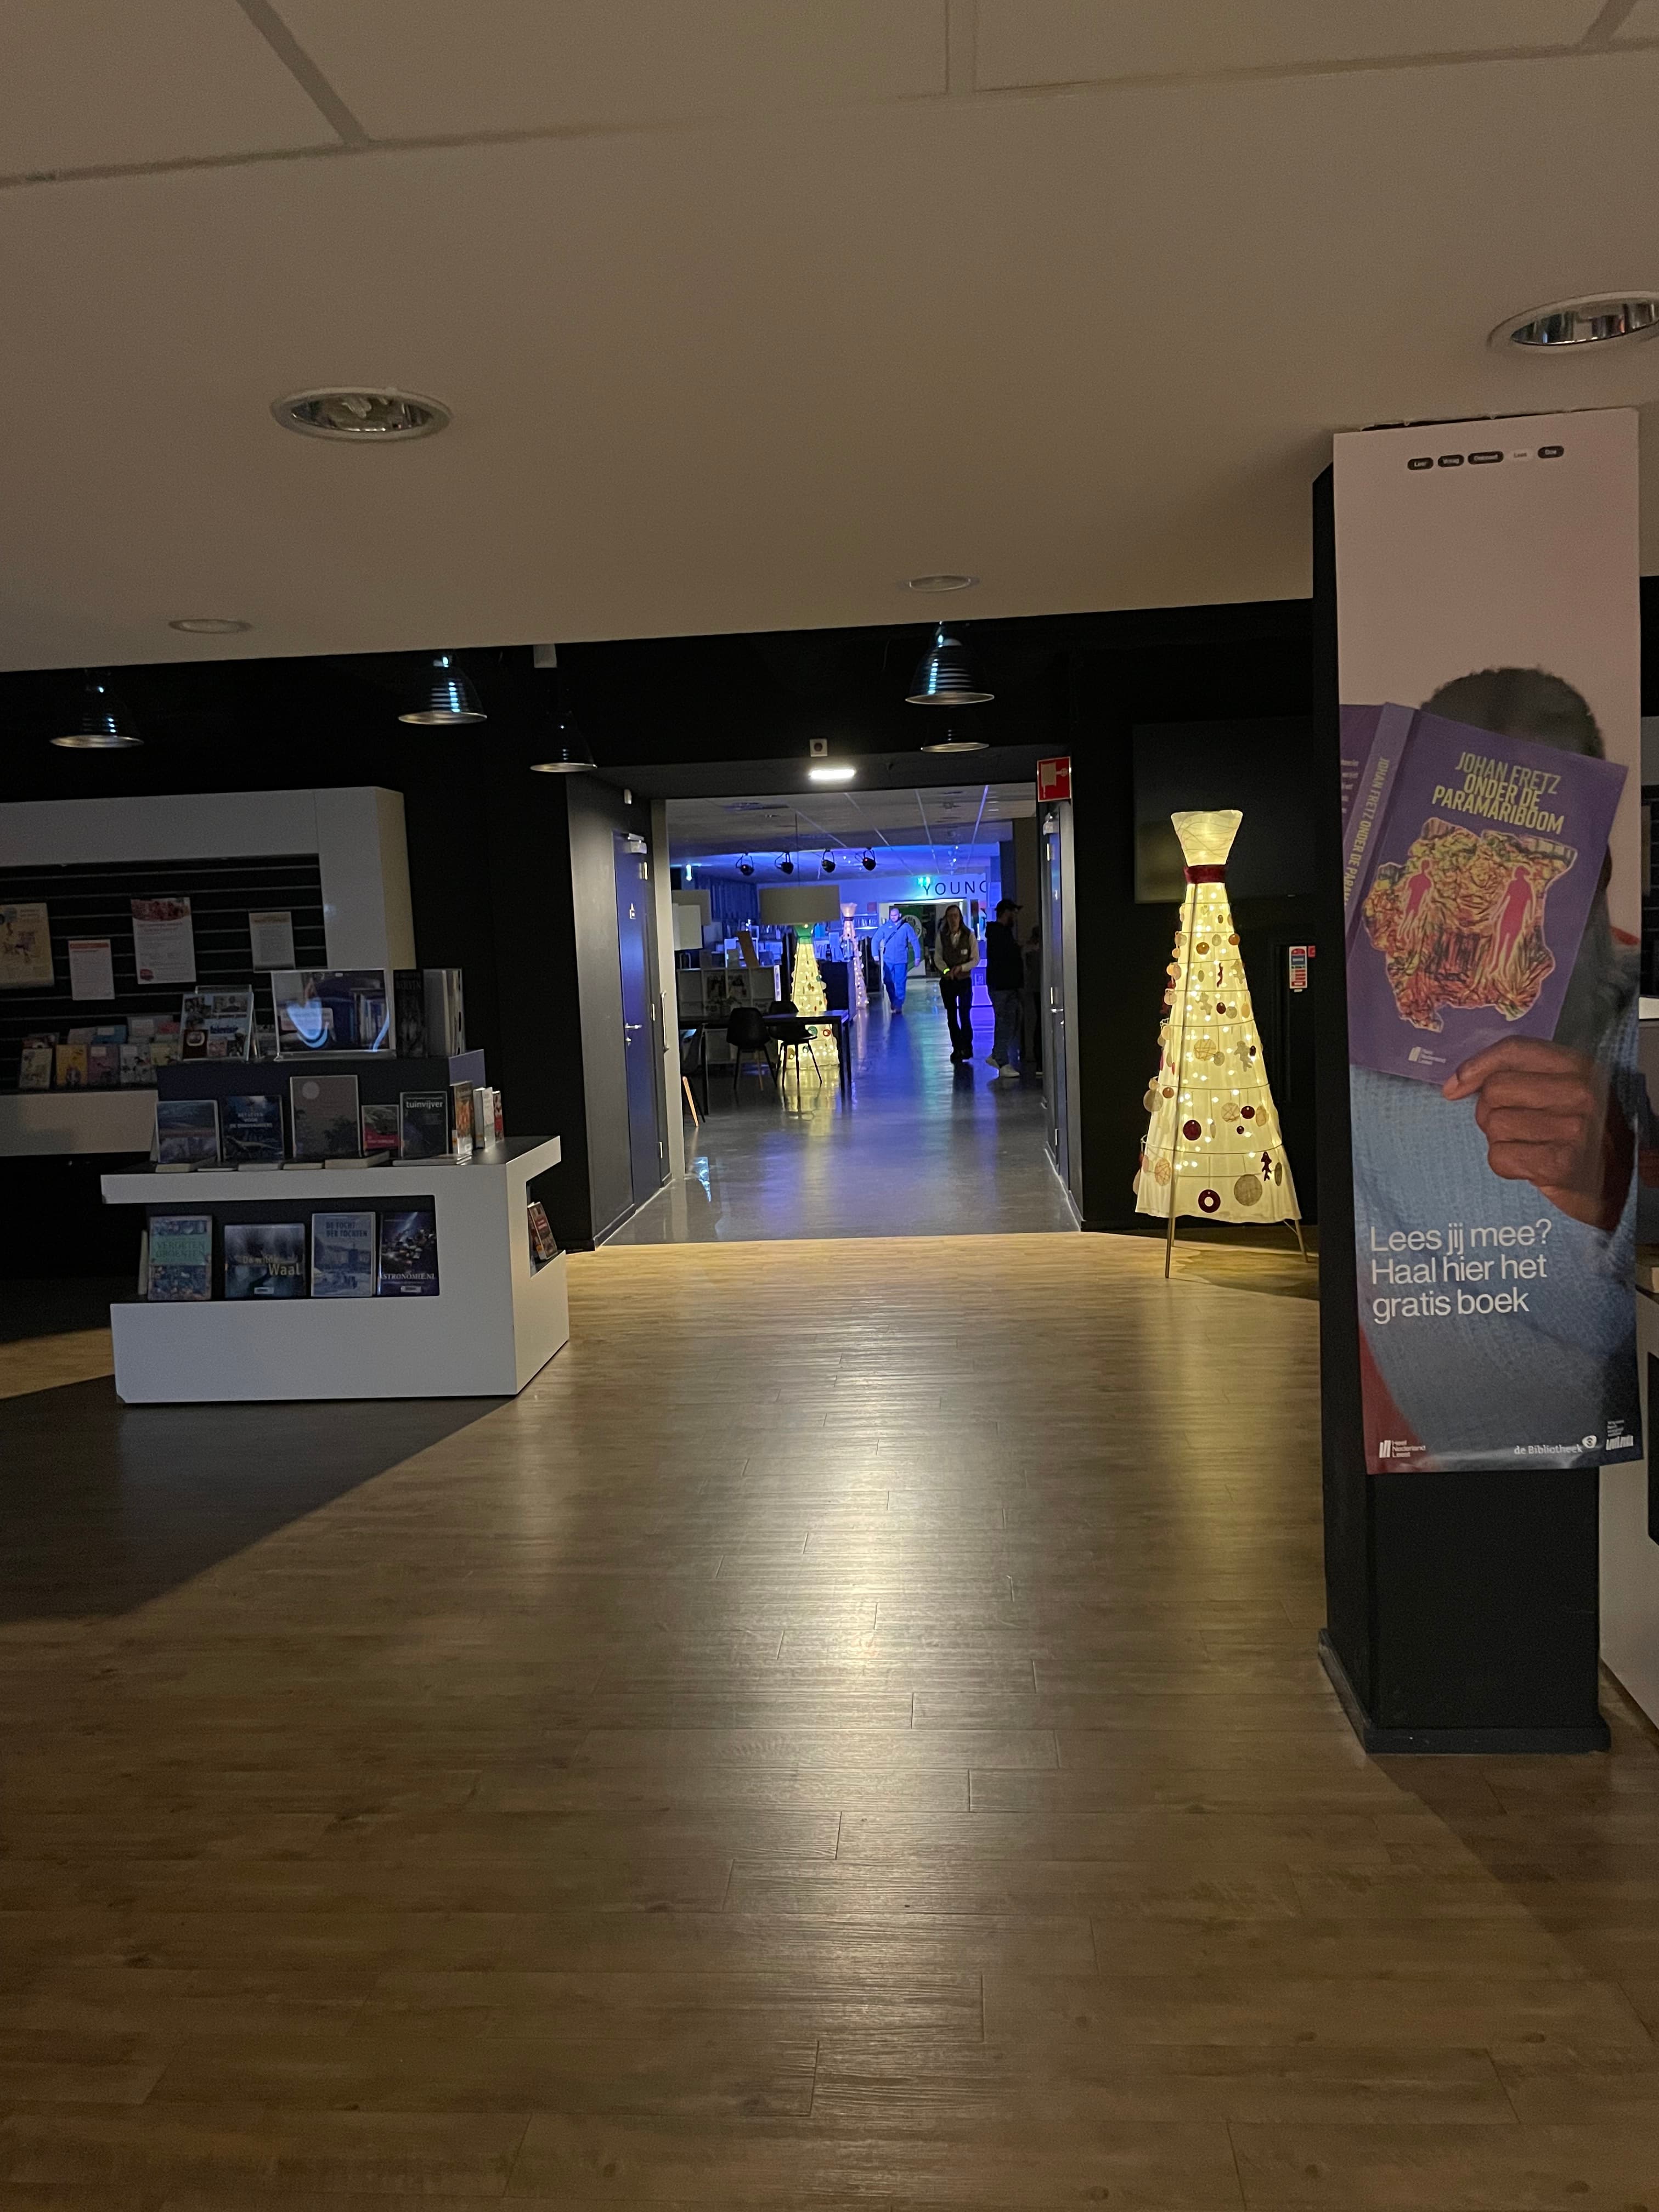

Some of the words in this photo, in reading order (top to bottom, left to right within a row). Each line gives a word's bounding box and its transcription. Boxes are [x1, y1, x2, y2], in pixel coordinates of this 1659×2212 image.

[1372, 757, 1390, 788] JOHAN
[1455, 752, 1508, 781] JOHAN
[1510, 766, 1561, 794] FRETZ
[1362, 790, 1381, 820] FRETZ
[1464, 774, 1518, 804] ONDER
[1520, 788, 1541, 810] DE
[1432, 785, 1565, 834] PARAMARIBOOM
[1353, 820, 1371, 852] ONDER
[1348, 853, 1362, 866] DE
[405, 1101, 443, 1109] tuinvijver
[1371, 1226, 1442, 1251] Lees
[1446, 1223, 1464, 1255] jij
[1471, 1218, 1552, 1247] mee?
[268, 1263, 301, 1276] Waal
[1372, 1257, 1436, 1284] Haal
[1443, 1255, 1494, 1282] hier
[1501, 1254, 1547, 1279] het
[1373, 1290, 1451, 1324] gratis
[1457, 1286, 1530, 1314] boek
[1514, 1445, 1526, 1454] de
[1528, 1444, 1583, 1454] Bibliotheek
